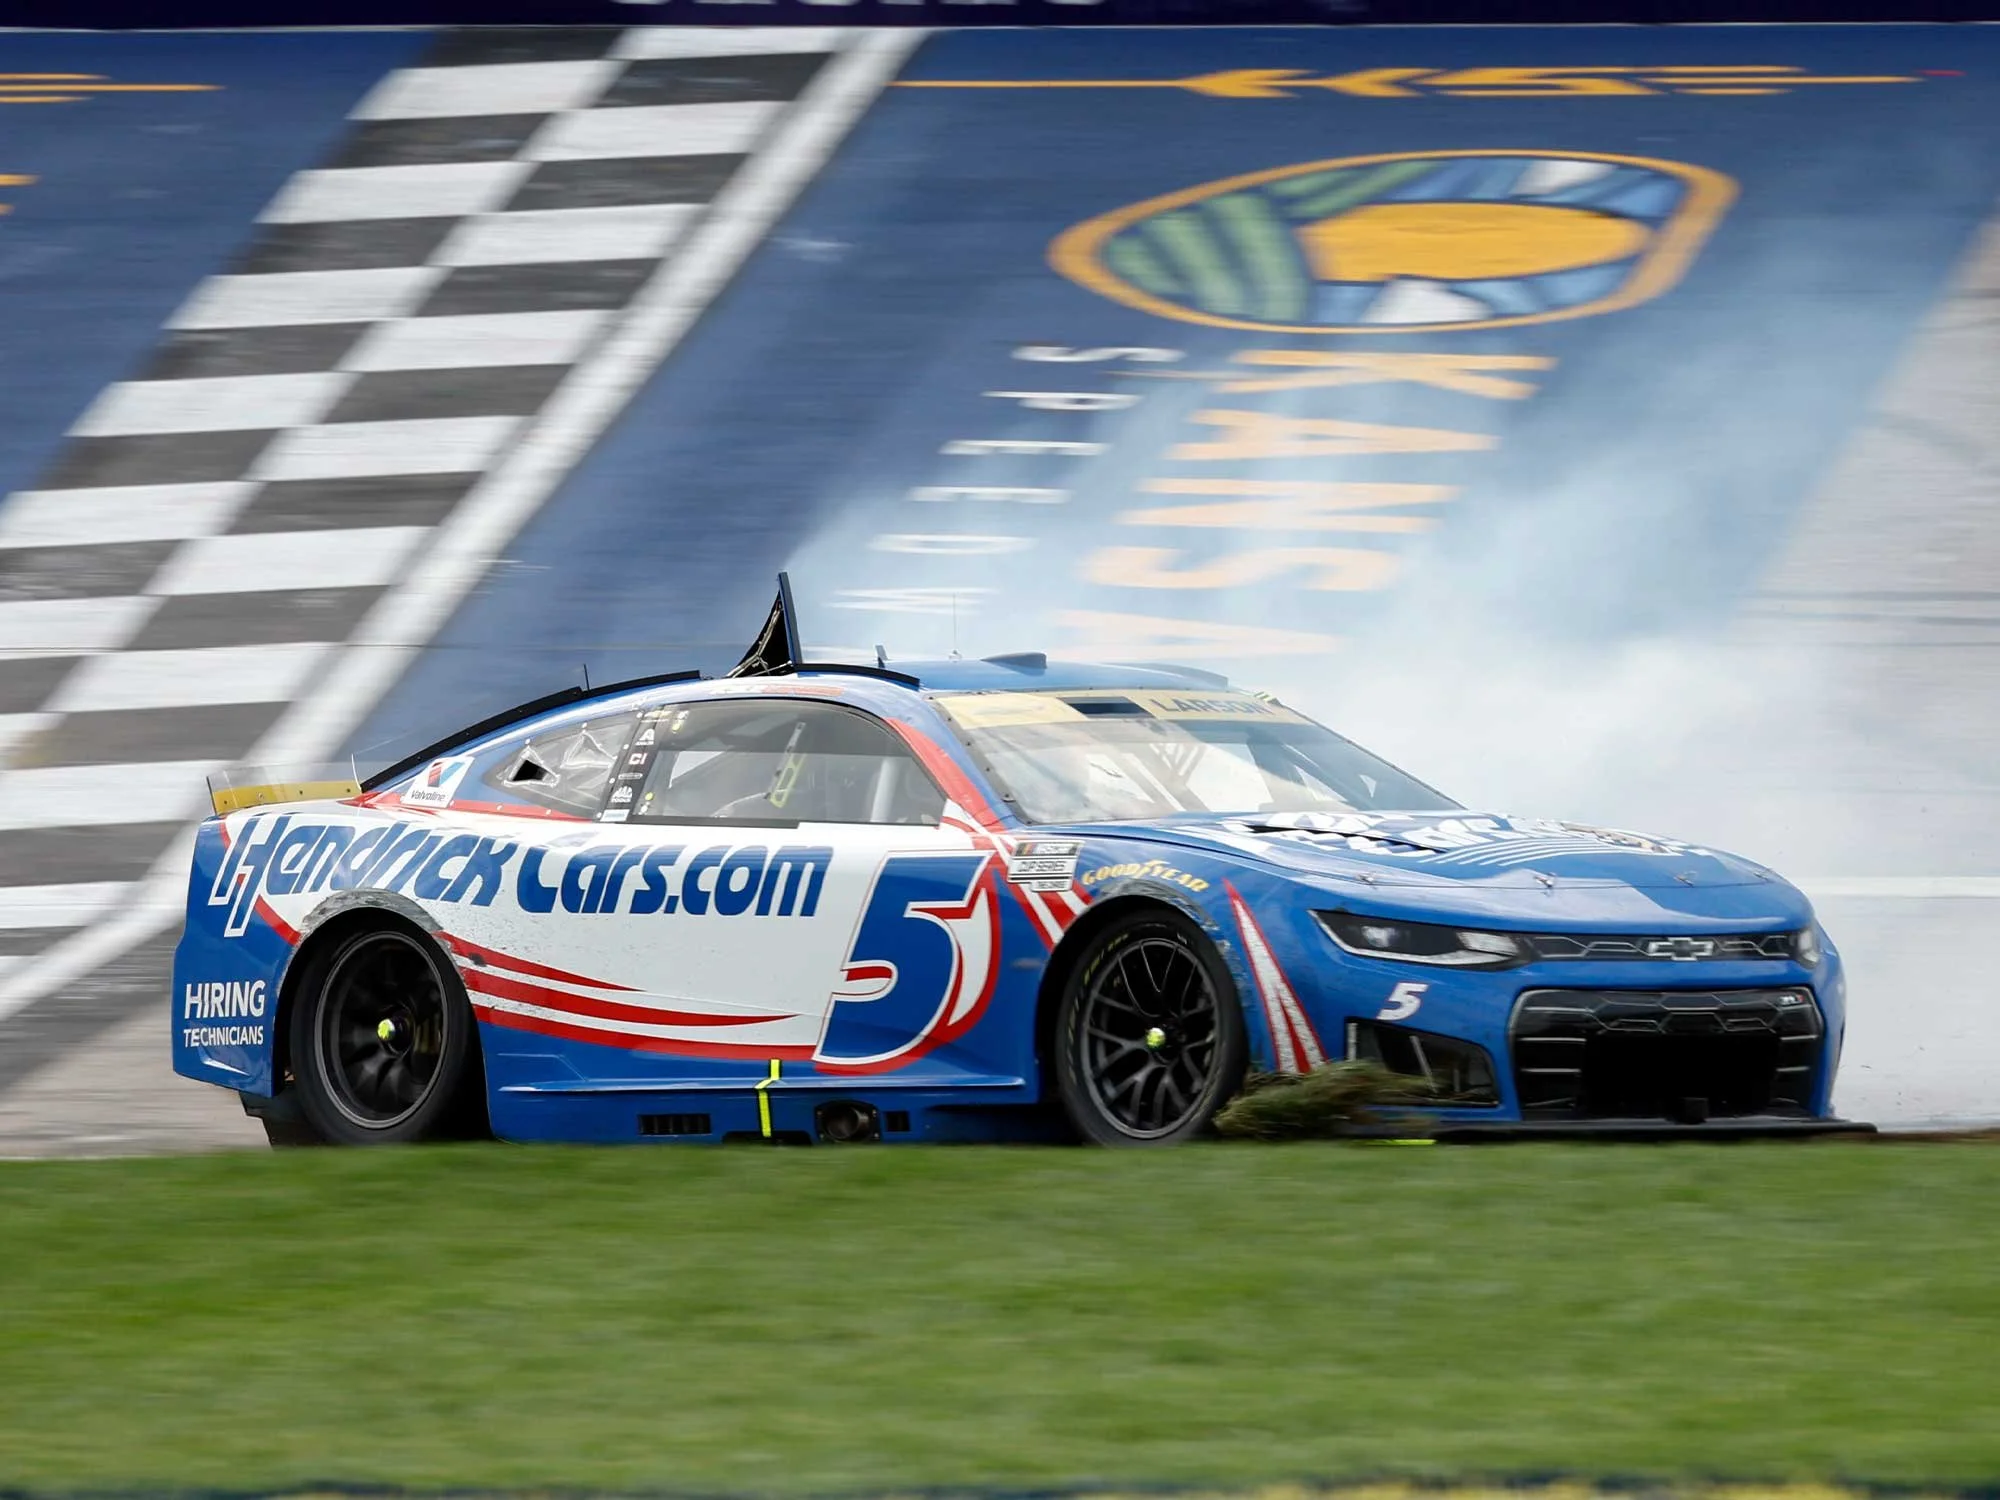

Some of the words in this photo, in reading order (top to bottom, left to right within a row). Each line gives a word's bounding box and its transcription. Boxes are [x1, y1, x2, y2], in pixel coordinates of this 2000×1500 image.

[1149, 699, 1276, 716] LARSON
[411, 790, 446, 801] Valvoline
[812, 849, 997, 1066] 5
[184, 980, 266, 1019] HIRING
[1378, 982, 1427, 1021] 5
[183, 1025, 264, 1048] TECHNICIANS
